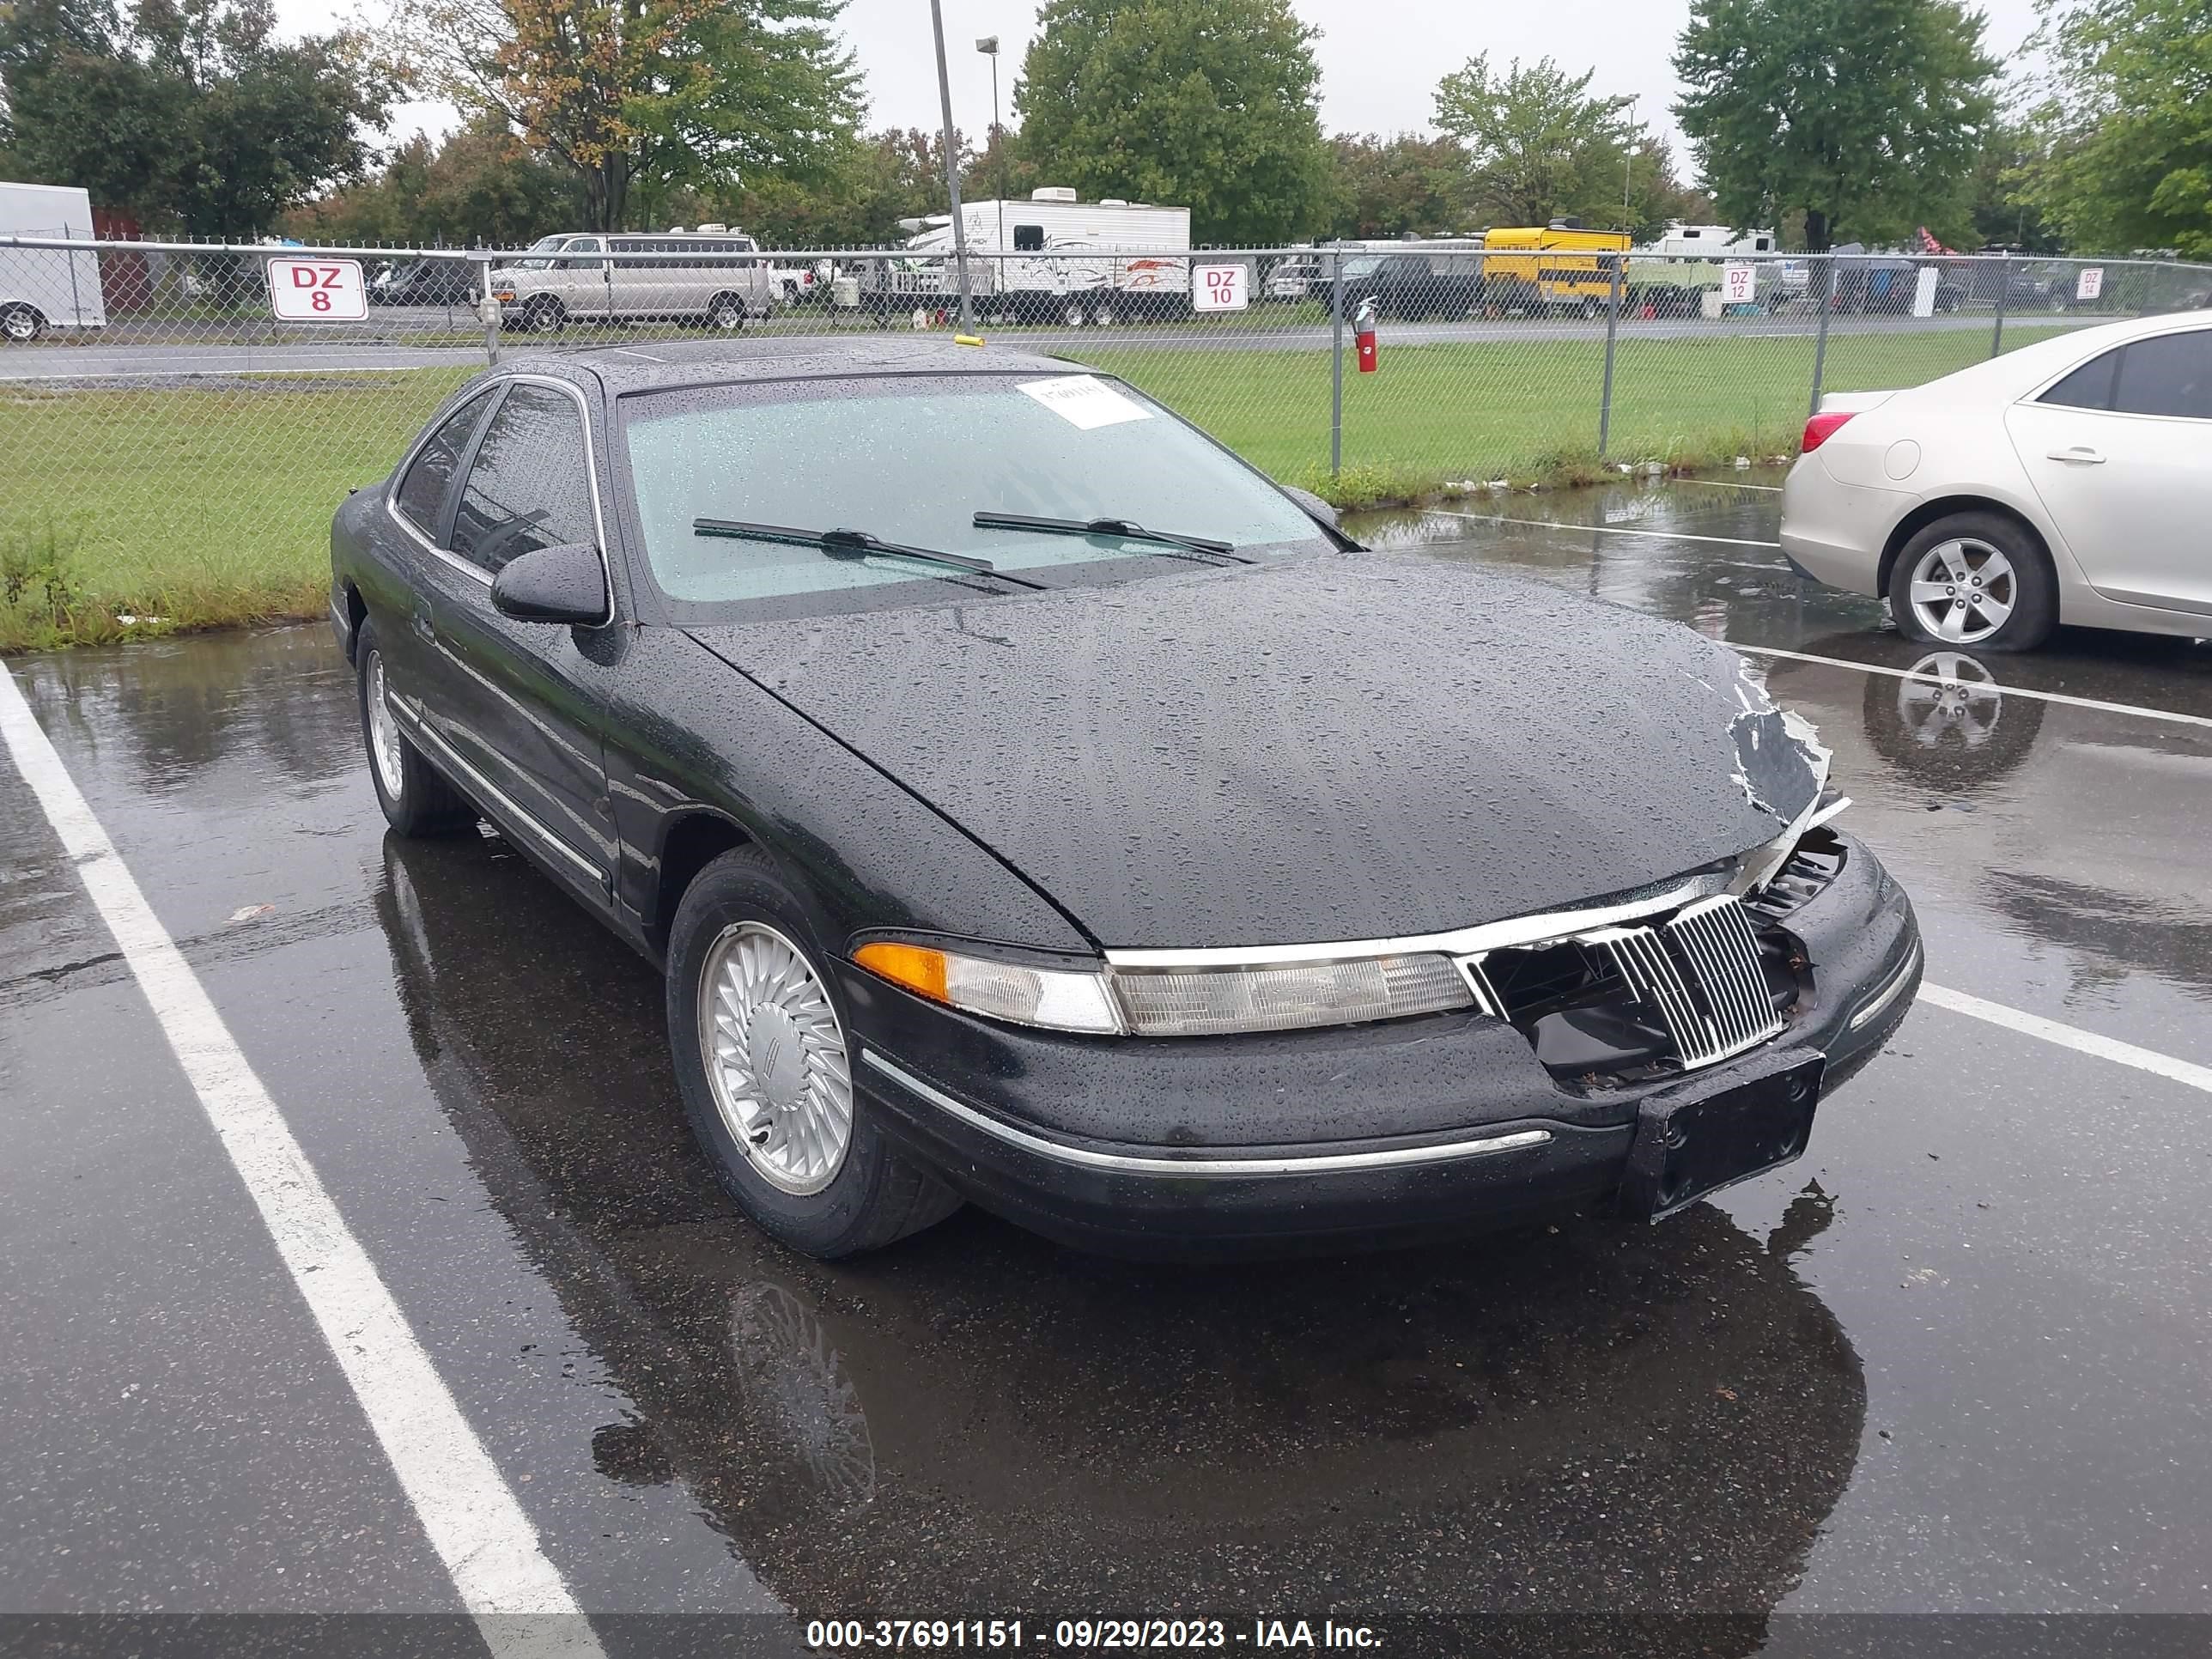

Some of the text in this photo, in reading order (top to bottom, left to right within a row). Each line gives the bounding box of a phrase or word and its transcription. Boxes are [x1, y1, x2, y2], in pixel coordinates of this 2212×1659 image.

[291, 266, 343, 289] DZ
[1207, 270, 1236, 288] DZ
[1730, 271, 1749, 284] DZ
[2085, 272, 2099, 283] DZ
[1210, 288, 1232, 303] 10
[1731, 285, 1745, 298] 12
[311, 290, 331, 312] 8
